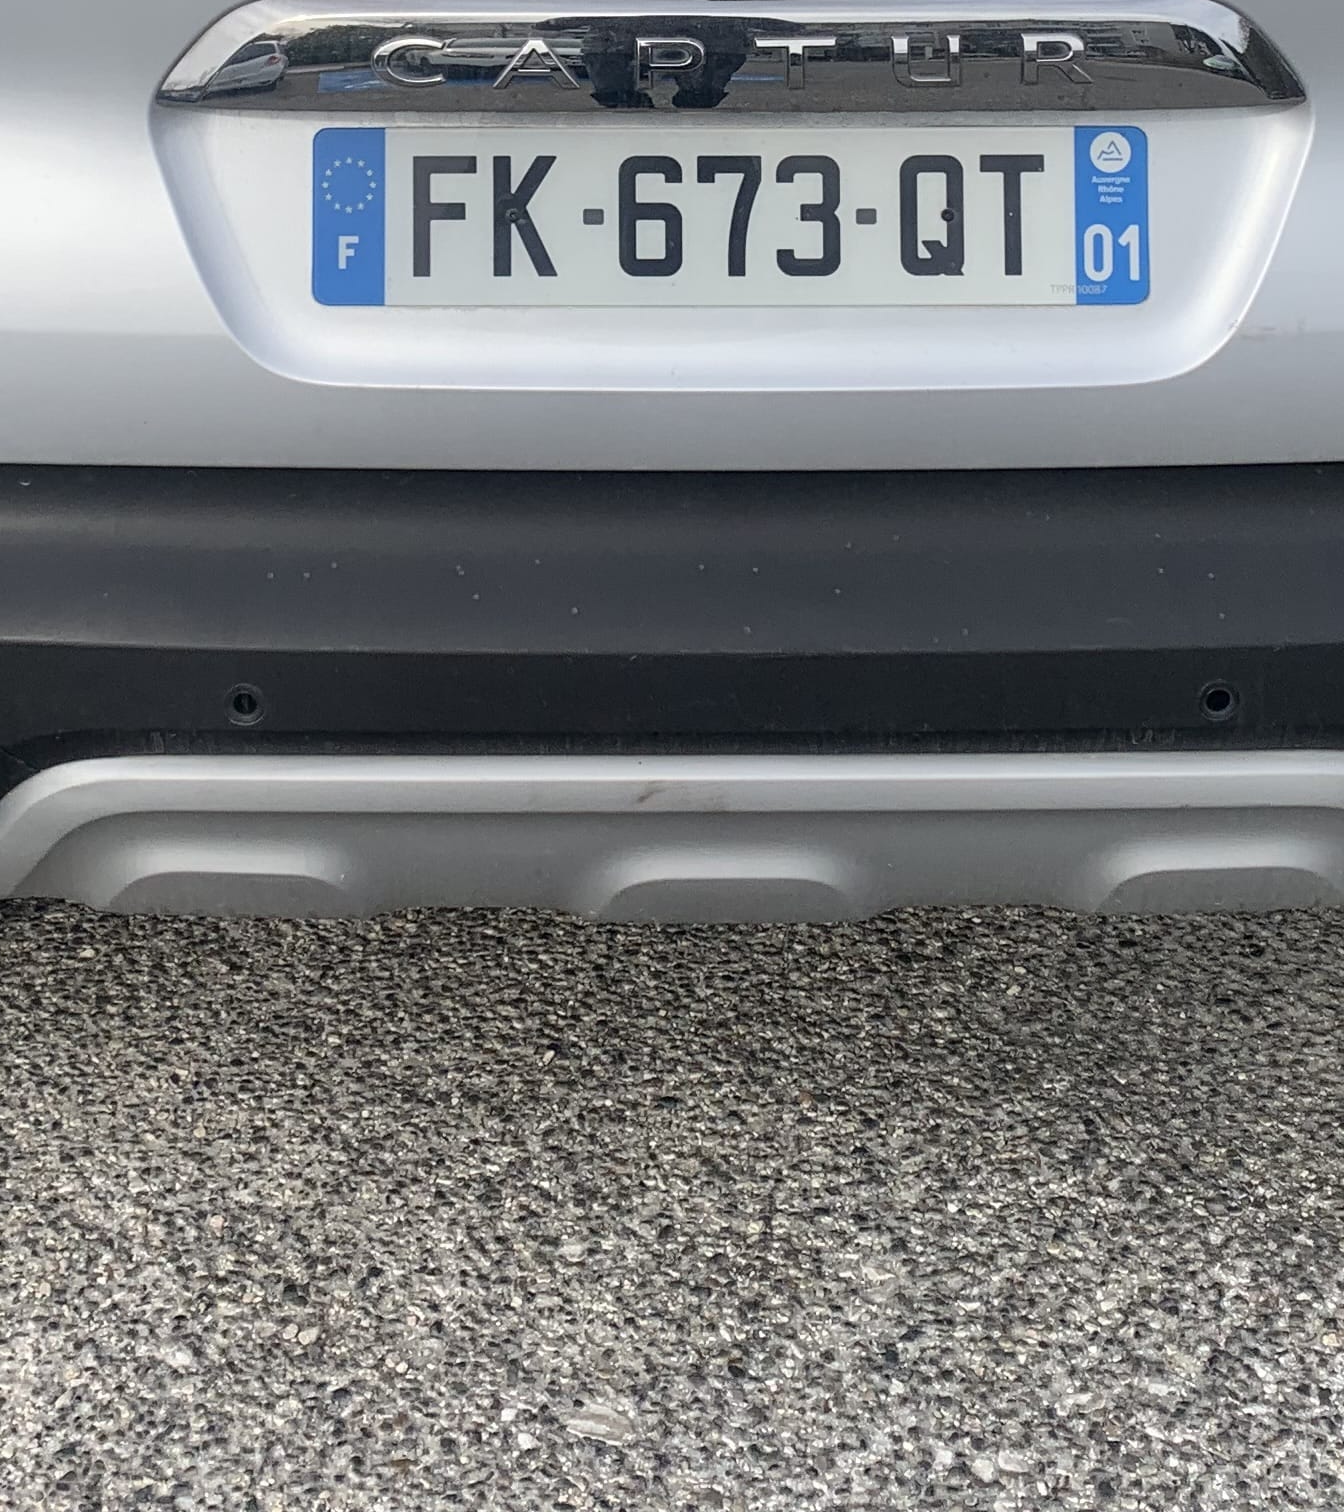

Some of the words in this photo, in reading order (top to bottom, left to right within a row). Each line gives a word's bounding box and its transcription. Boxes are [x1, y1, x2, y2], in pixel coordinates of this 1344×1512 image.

[370, 34, 1094, 89] CAPTUR
[1090, 175, 1131, 185] Auvergne
[1097, 184, 1124, 194] Rhône
[412, 154, 1046, 278] FK-673-QT
[1099, 194, 1123, 204] Alpes
[337, 235, 359, 270] F
[1083, 223, 1141, 283] 01
